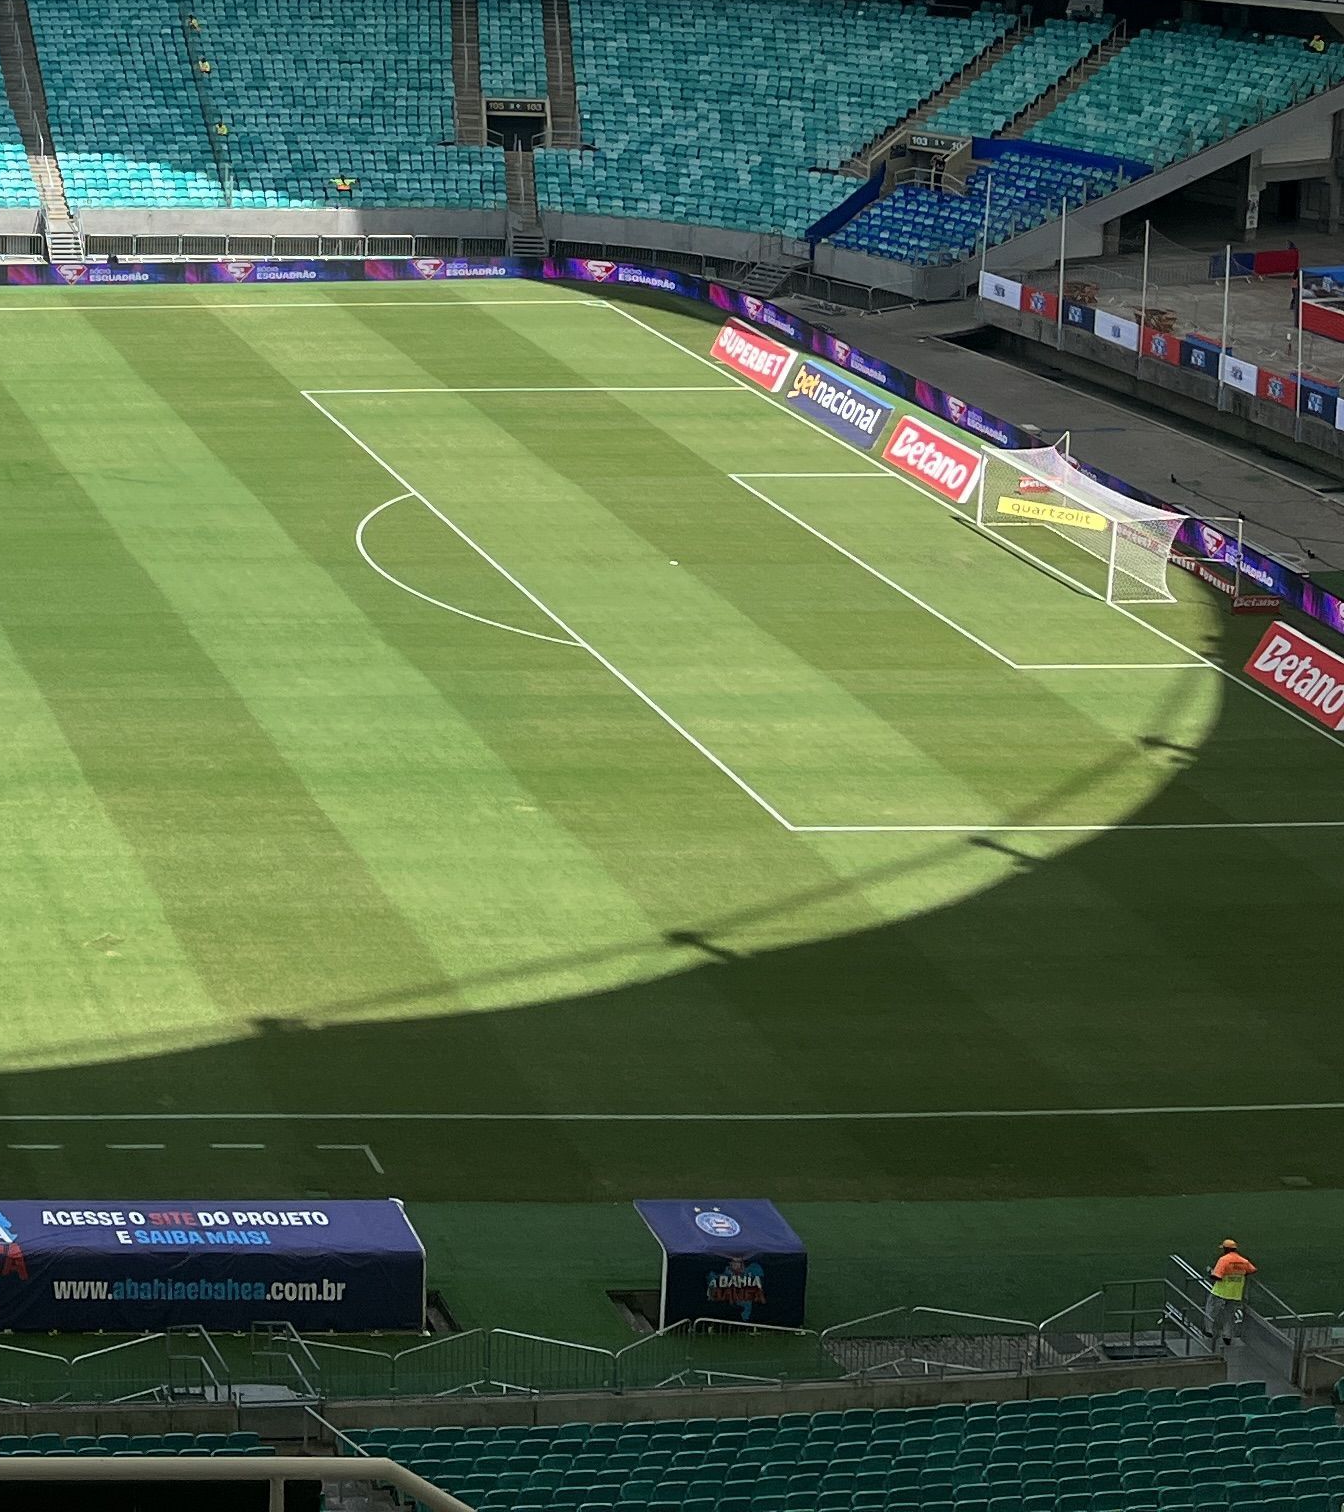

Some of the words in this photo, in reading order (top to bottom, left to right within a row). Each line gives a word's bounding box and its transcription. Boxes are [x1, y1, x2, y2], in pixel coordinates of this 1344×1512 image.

[89, 272, 149, 281] ESQUADRÃO
[257, 270, 316, 280] ESQUADRÃO
[446, 267, 505, 276] ESQUADRÃO
[619, 273, 676, 290] ESQUADRÃO
[719, 326, 785, 377] SUPERBET
[790, 365, 881, 434] betnacional
[891, 427, 967, 489] Betano
[1010, 502, 1091, 526] quartzolit
[1253, 635, 1344, 714] Betano
[41, 1210, 126, 1226] ACESSE
[128, 1211, 146, 1225] O
[149, 1211, 197, 1227] SITE
[199, 1210, 230, 1227] DO
[234, 1210, 329, 1226] PROJETO
[116, 1229, 132, 1245] E
[134, 1229, 205, 1245] SAIBA
[205, 1229, 272, 1245] MAIS!
[53, 1278, 346, 1302] www.abahiaebahea.com.br
